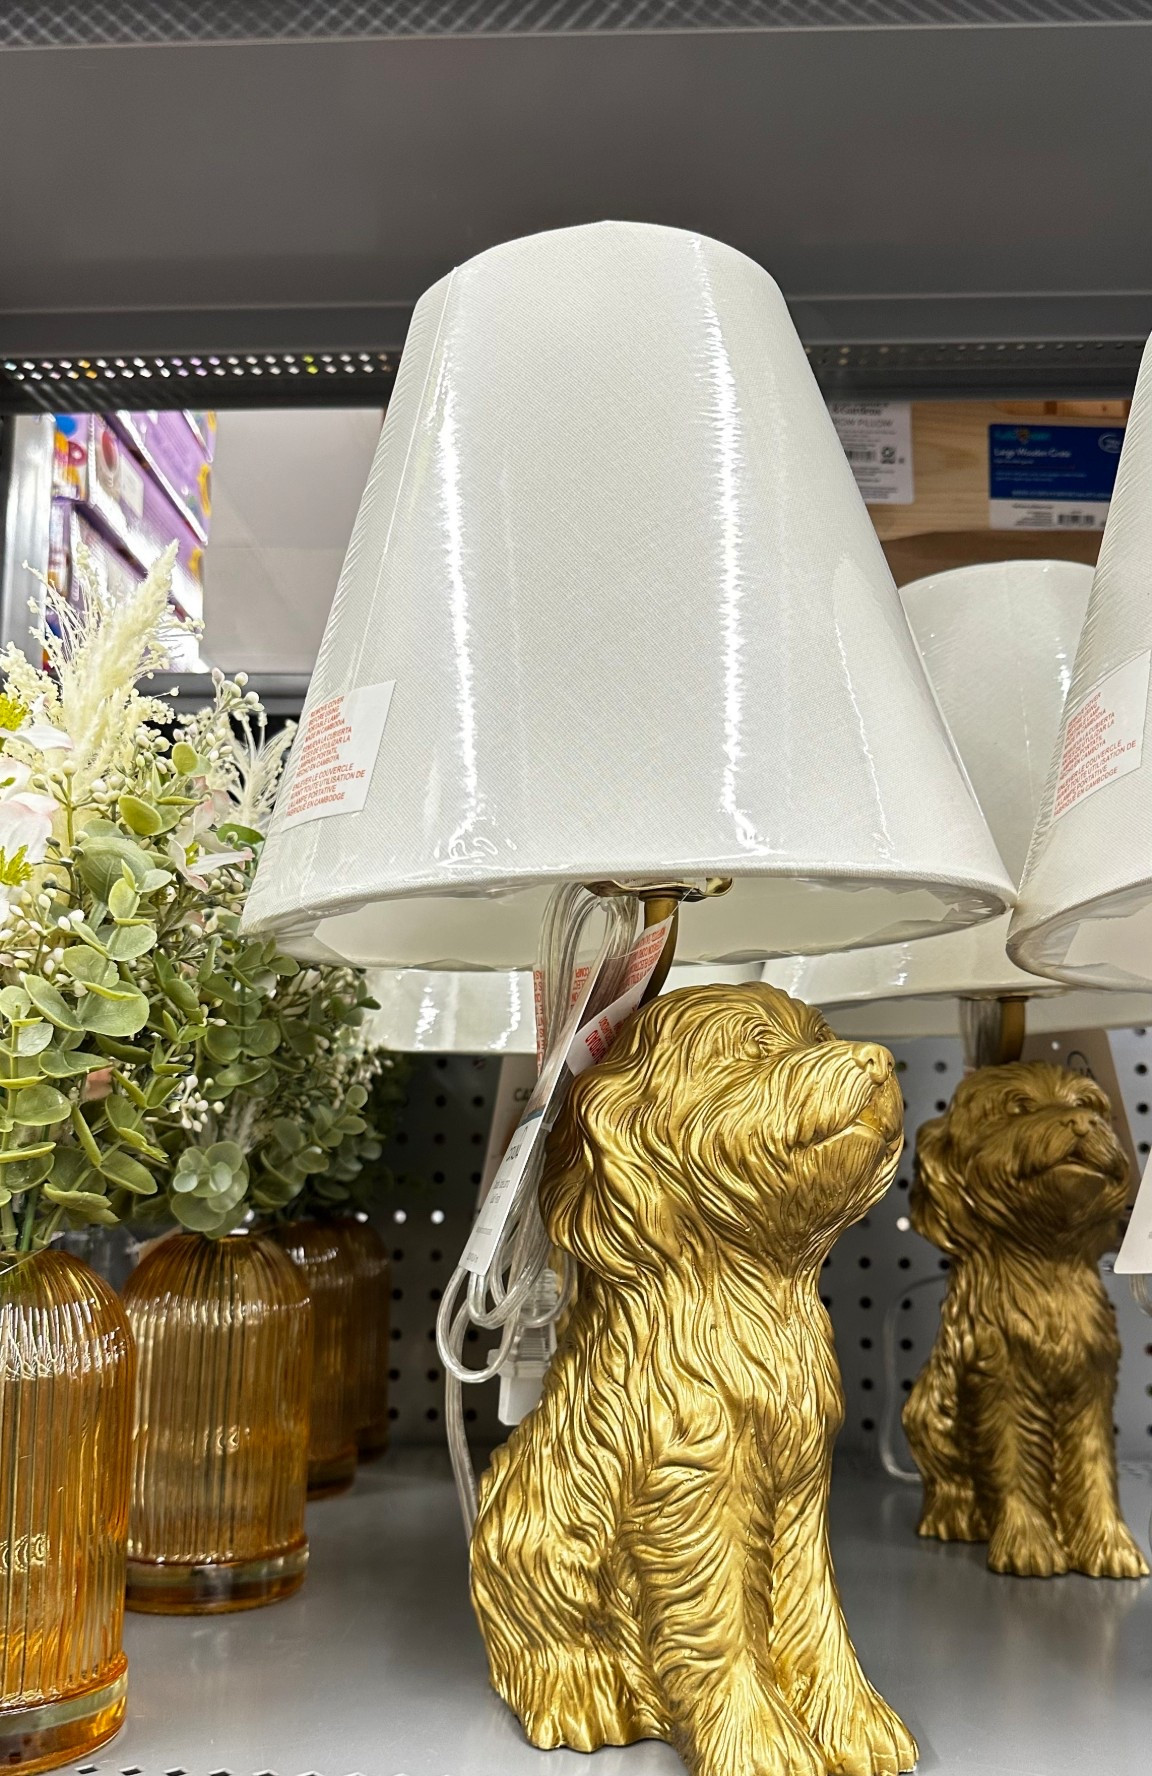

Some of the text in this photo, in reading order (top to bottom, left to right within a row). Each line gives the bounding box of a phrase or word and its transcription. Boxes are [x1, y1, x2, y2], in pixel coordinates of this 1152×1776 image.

[1089, 711, 1115, 735] CUBIERTA
[327, 726, 352, 741] CUBIERTA
[342, 734, 350, 744] LA
[1081, 739, 1106, 760] CAMBOYA
[1085, 739, 1122, 769] COUVERCLE
[1088, 746, 1126, 775] UTILISATION
[1126, 739, 1137, 751] DE
[319, 762, 354, 779] COUVERCLE
[320, 771, 356, 788] UTILISATION
[355, 769, 366, 779] DE
[1077, 764, 1108, 790] PORTATIVE
[1085, 766, 1118, 791] CAMBODGE
[308, 784, 338, 800] PORTATIVE
[314, 792, 346, 806] CAMBODGE
